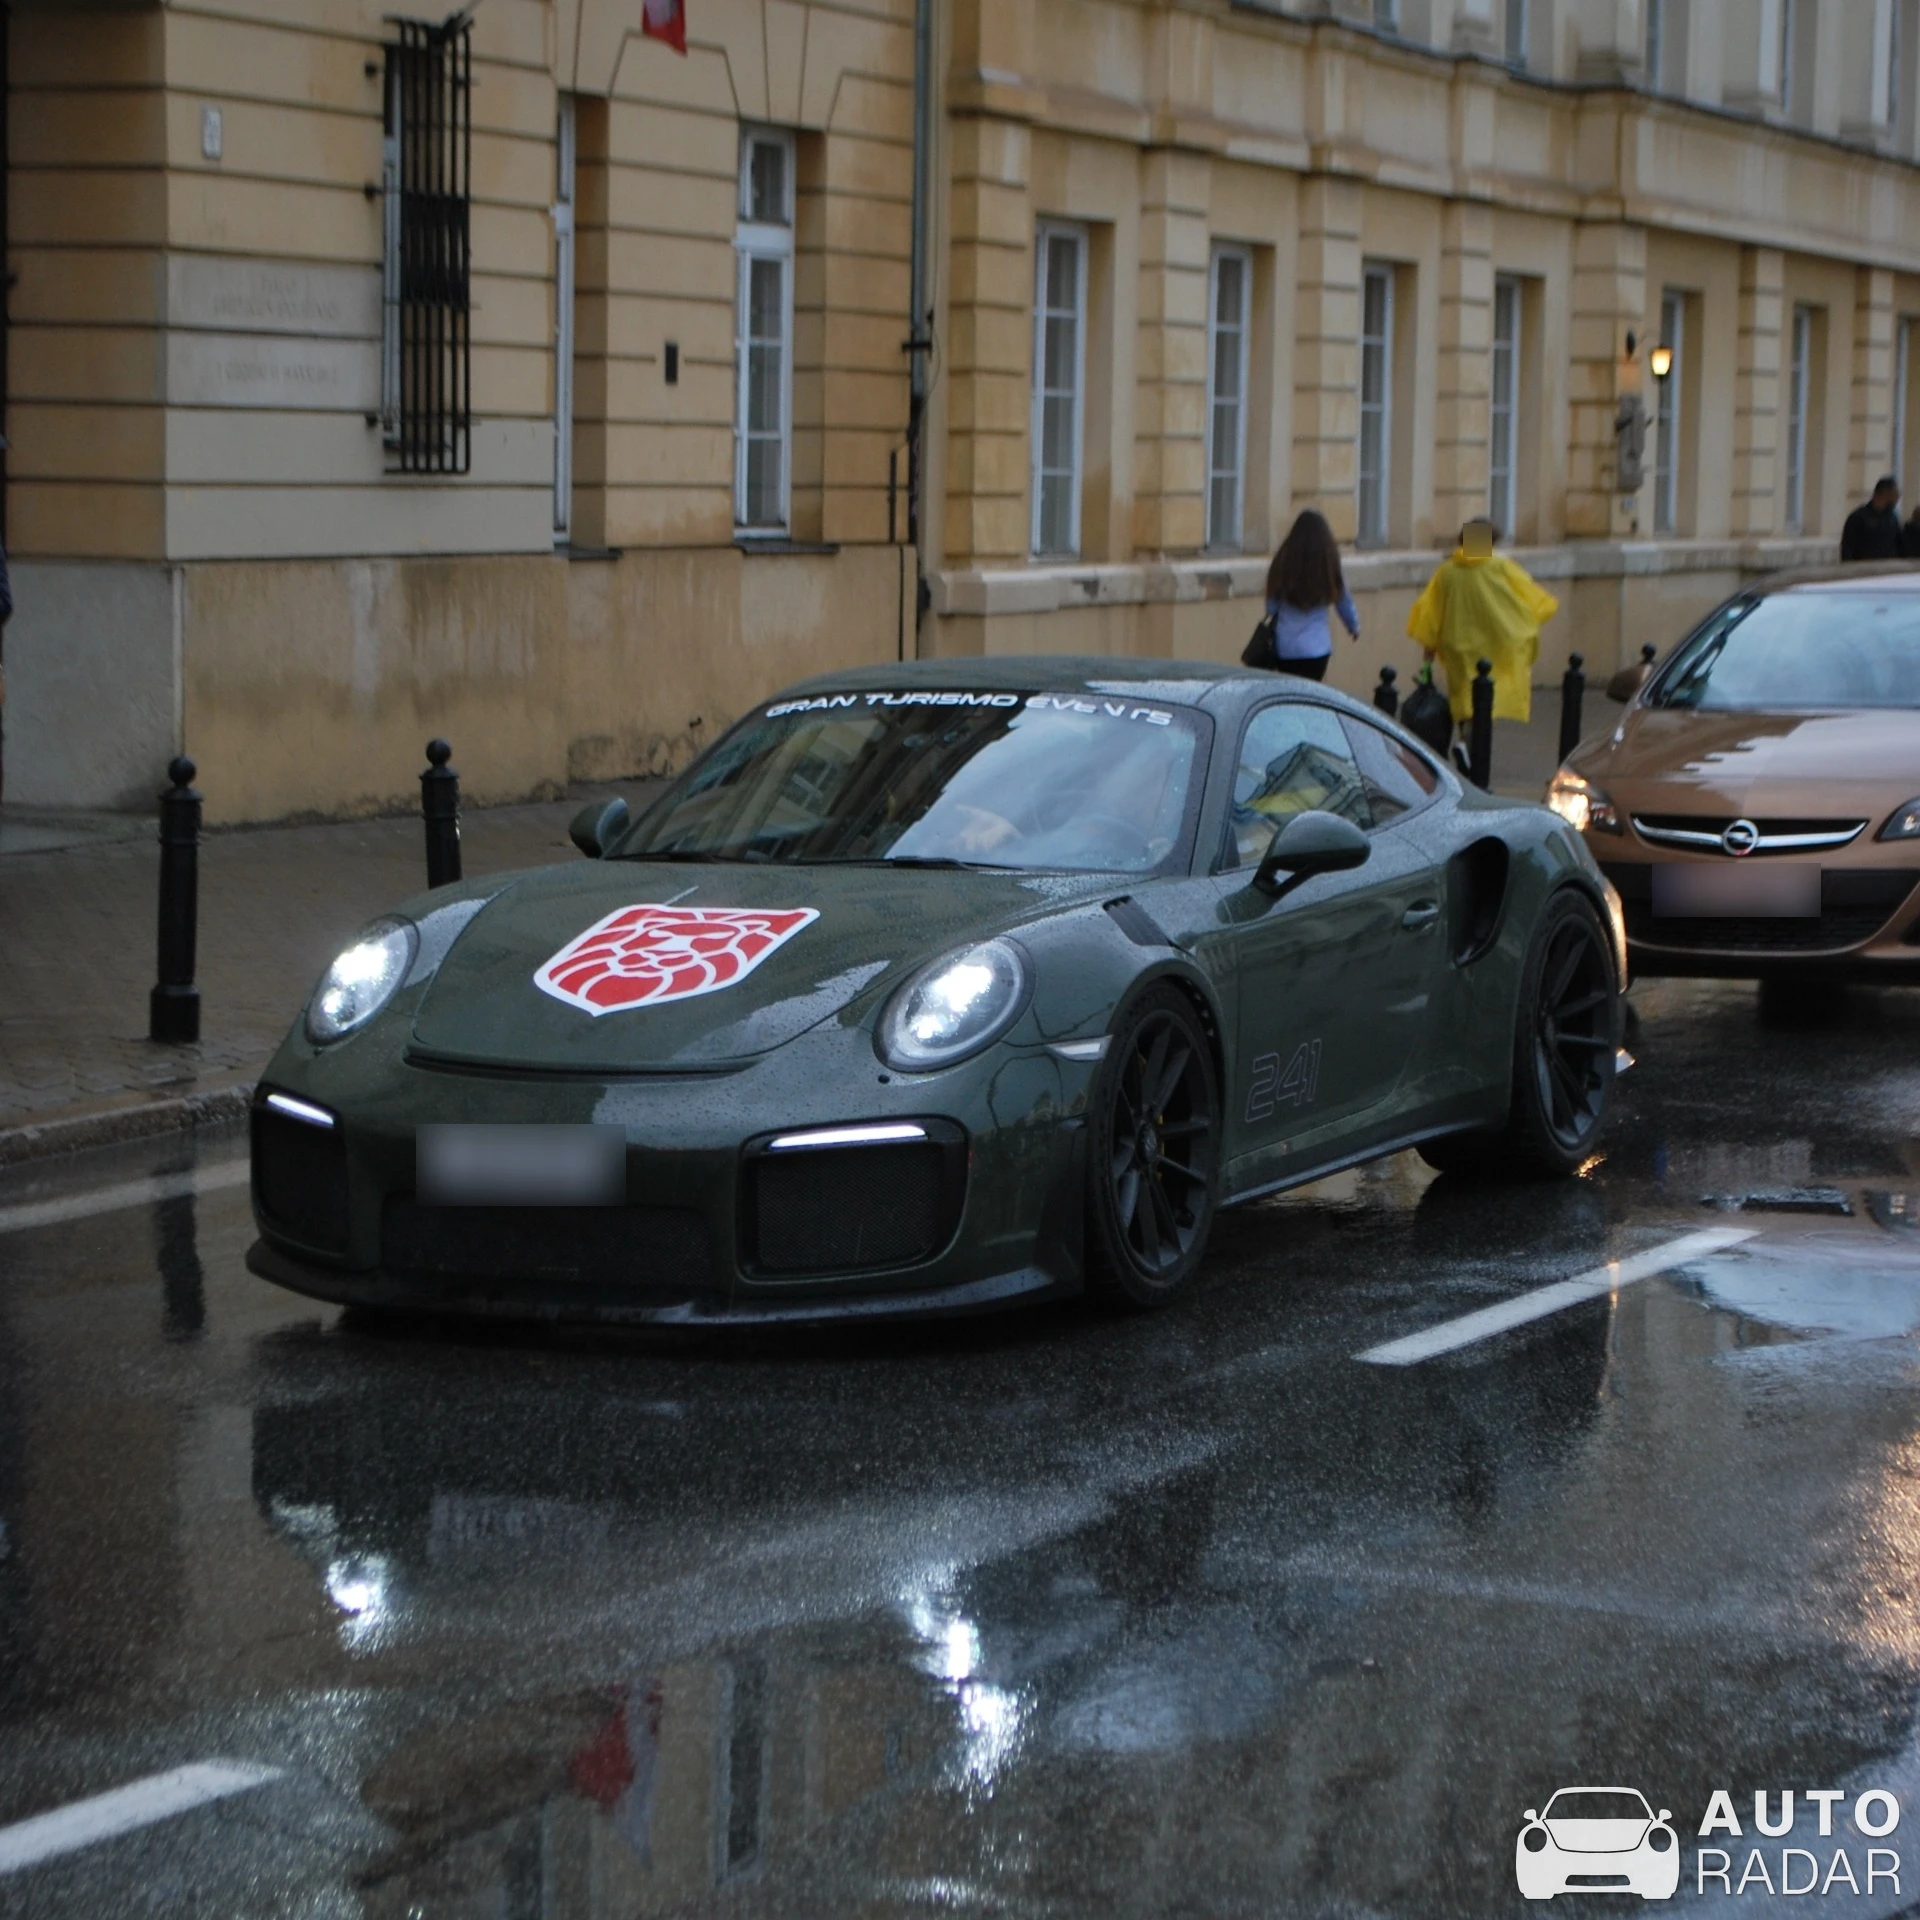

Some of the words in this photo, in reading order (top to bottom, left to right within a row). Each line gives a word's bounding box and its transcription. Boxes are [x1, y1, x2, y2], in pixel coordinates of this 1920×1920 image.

[766, 695, 857, 718] GRAN
[865, 692, 1018, 707] TURISMO
[1245, 1038, 1322, 1123] 241
